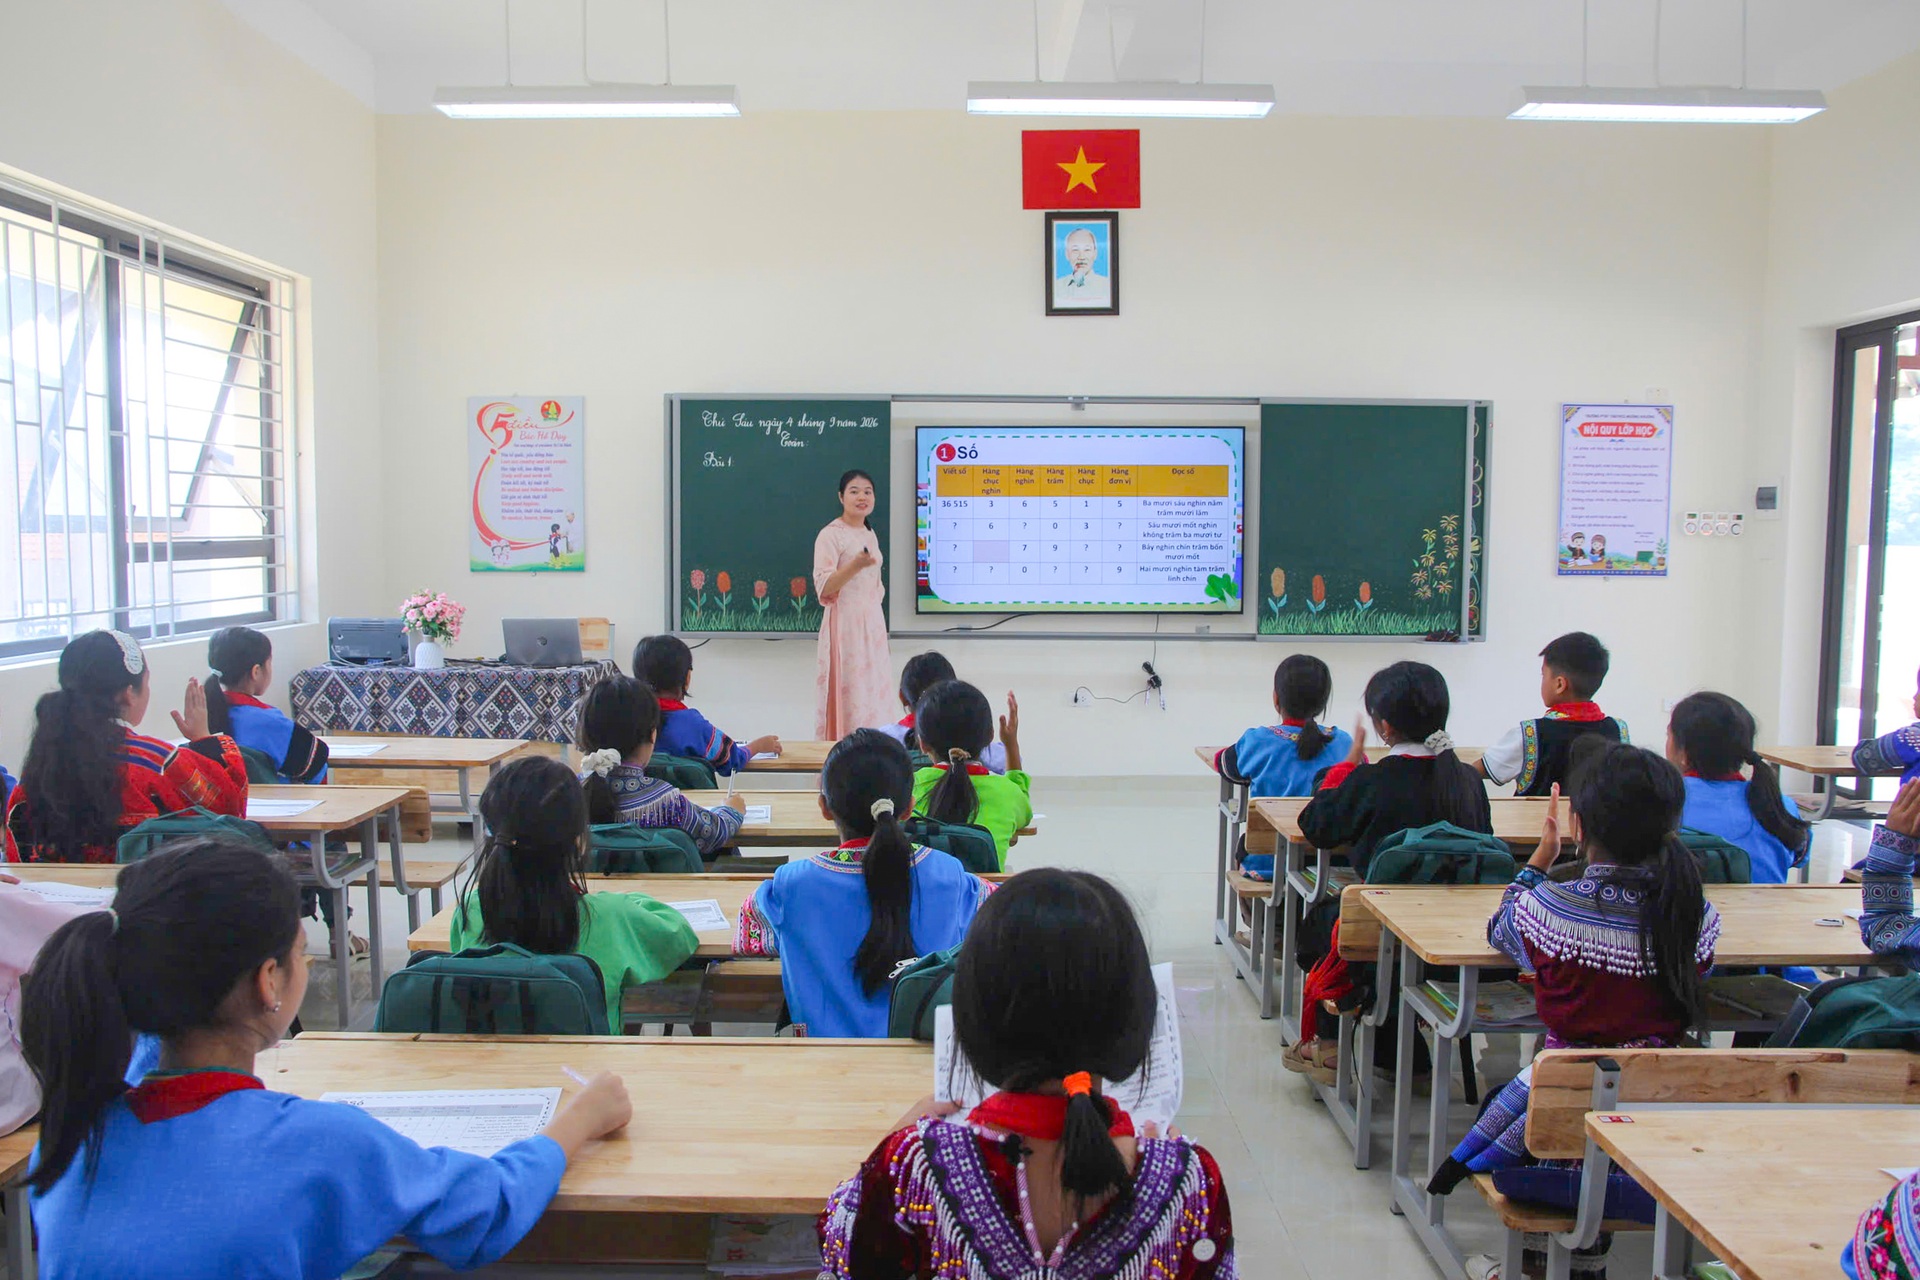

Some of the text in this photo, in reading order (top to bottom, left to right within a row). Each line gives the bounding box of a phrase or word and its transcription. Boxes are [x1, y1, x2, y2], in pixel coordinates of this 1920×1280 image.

[702, 410, 725, 427] Thứ
[759, 418, 784, 435] ngày
[786, 417, 793, 427] 4
[830, 417, 835, 427] 9
[860, 417, 878, 427] 2026
[491, 413, 514, 450] 5
[1583, 423, 1653, 437] NỘI QUY LỚP HỌC
[958, 444, 979, 459] Số
[943, 467, 966, 475] Viết số
[983, 468, 1000, 476] Hàng
[1047, 468, 1064, 476] Hàng
[1078, 468, 1095, 476] Hàng
[1112, 468, 1128, 476] Hàng
[1172, 468, 1184, 476] Đọc
[983, 478, 998, 486] chục
[1079, 478, 1094, 486] chục
[1125, 478, 1131, 486] vị
[942, 500, 968, 508] 36 515
[988, 500, 994, 508] 3
[1021, 500, 1028, 508] 6
[1052, 500, 1059, 508] 5
[1084, 500, 1089, 508] 1
[1117, 500, 1123, 508] 5
[988, 522, 994, 530] 6
[1052, 522, 1059, 530] 0
[1083, 522, 1089, 530] 3
[1143, 532, 1164, 540] không
[1022, 544, 1028, 552] 7
[1052, 544, 1058, 552] 9
[1186, 553, 1199, 561] mốt
[1021, 566, 1028, 574] 0
[1116, 566, 1123, 574] 9
